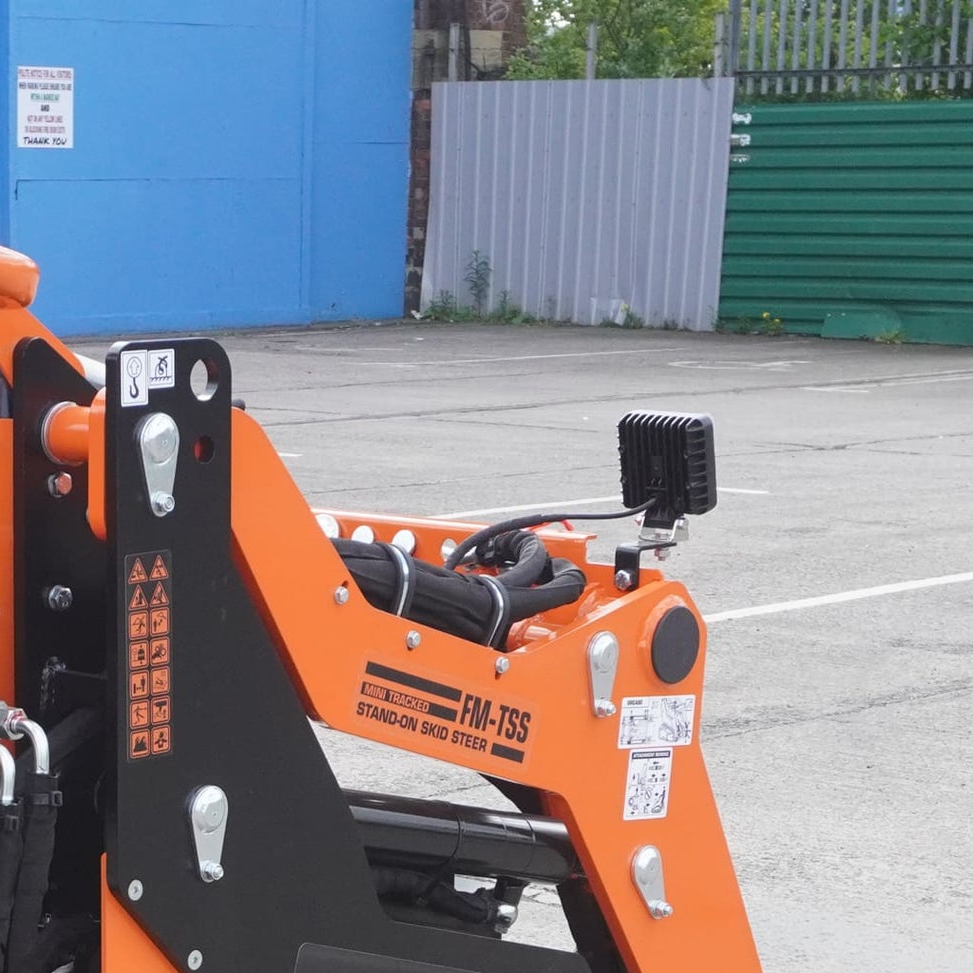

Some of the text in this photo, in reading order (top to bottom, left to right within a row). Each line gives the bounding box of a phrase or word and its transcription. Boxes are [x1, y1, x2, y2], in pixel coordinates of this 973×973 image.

[23, 137, 67, 146] THANK YOU
[363, 683, 429, 713] MINI TRACKED
[356, 701, 488, 753] STAND-ON SKID STEER
[459, 693, 531, 744] FM-TSS
